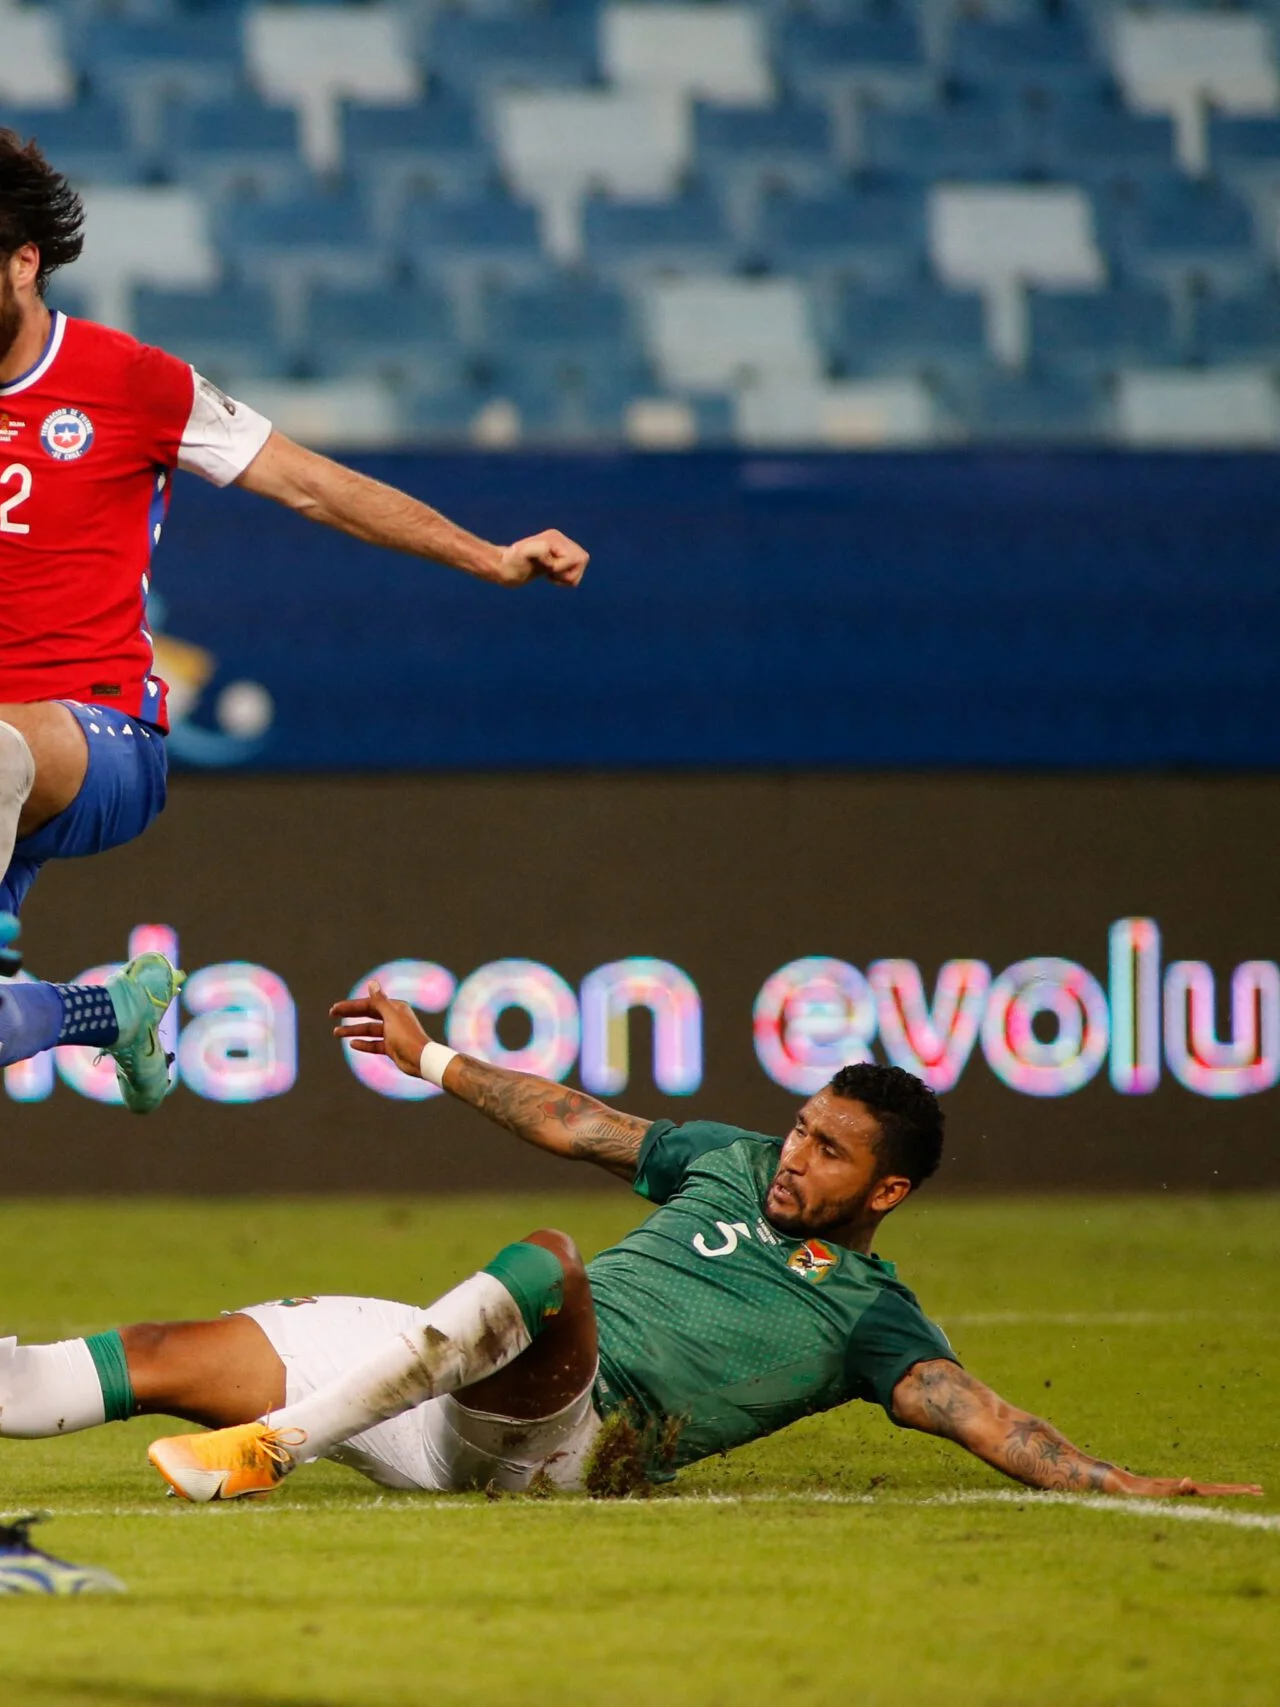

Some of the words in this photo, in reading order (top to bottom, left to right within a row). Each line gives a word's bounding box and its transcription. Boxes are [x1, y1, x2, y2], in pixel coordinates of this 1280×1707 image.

[341, 956, 703, 1100] con
[754, 916, 1280, 1100] evolu
[692, 1221, 752, 1257] 5
